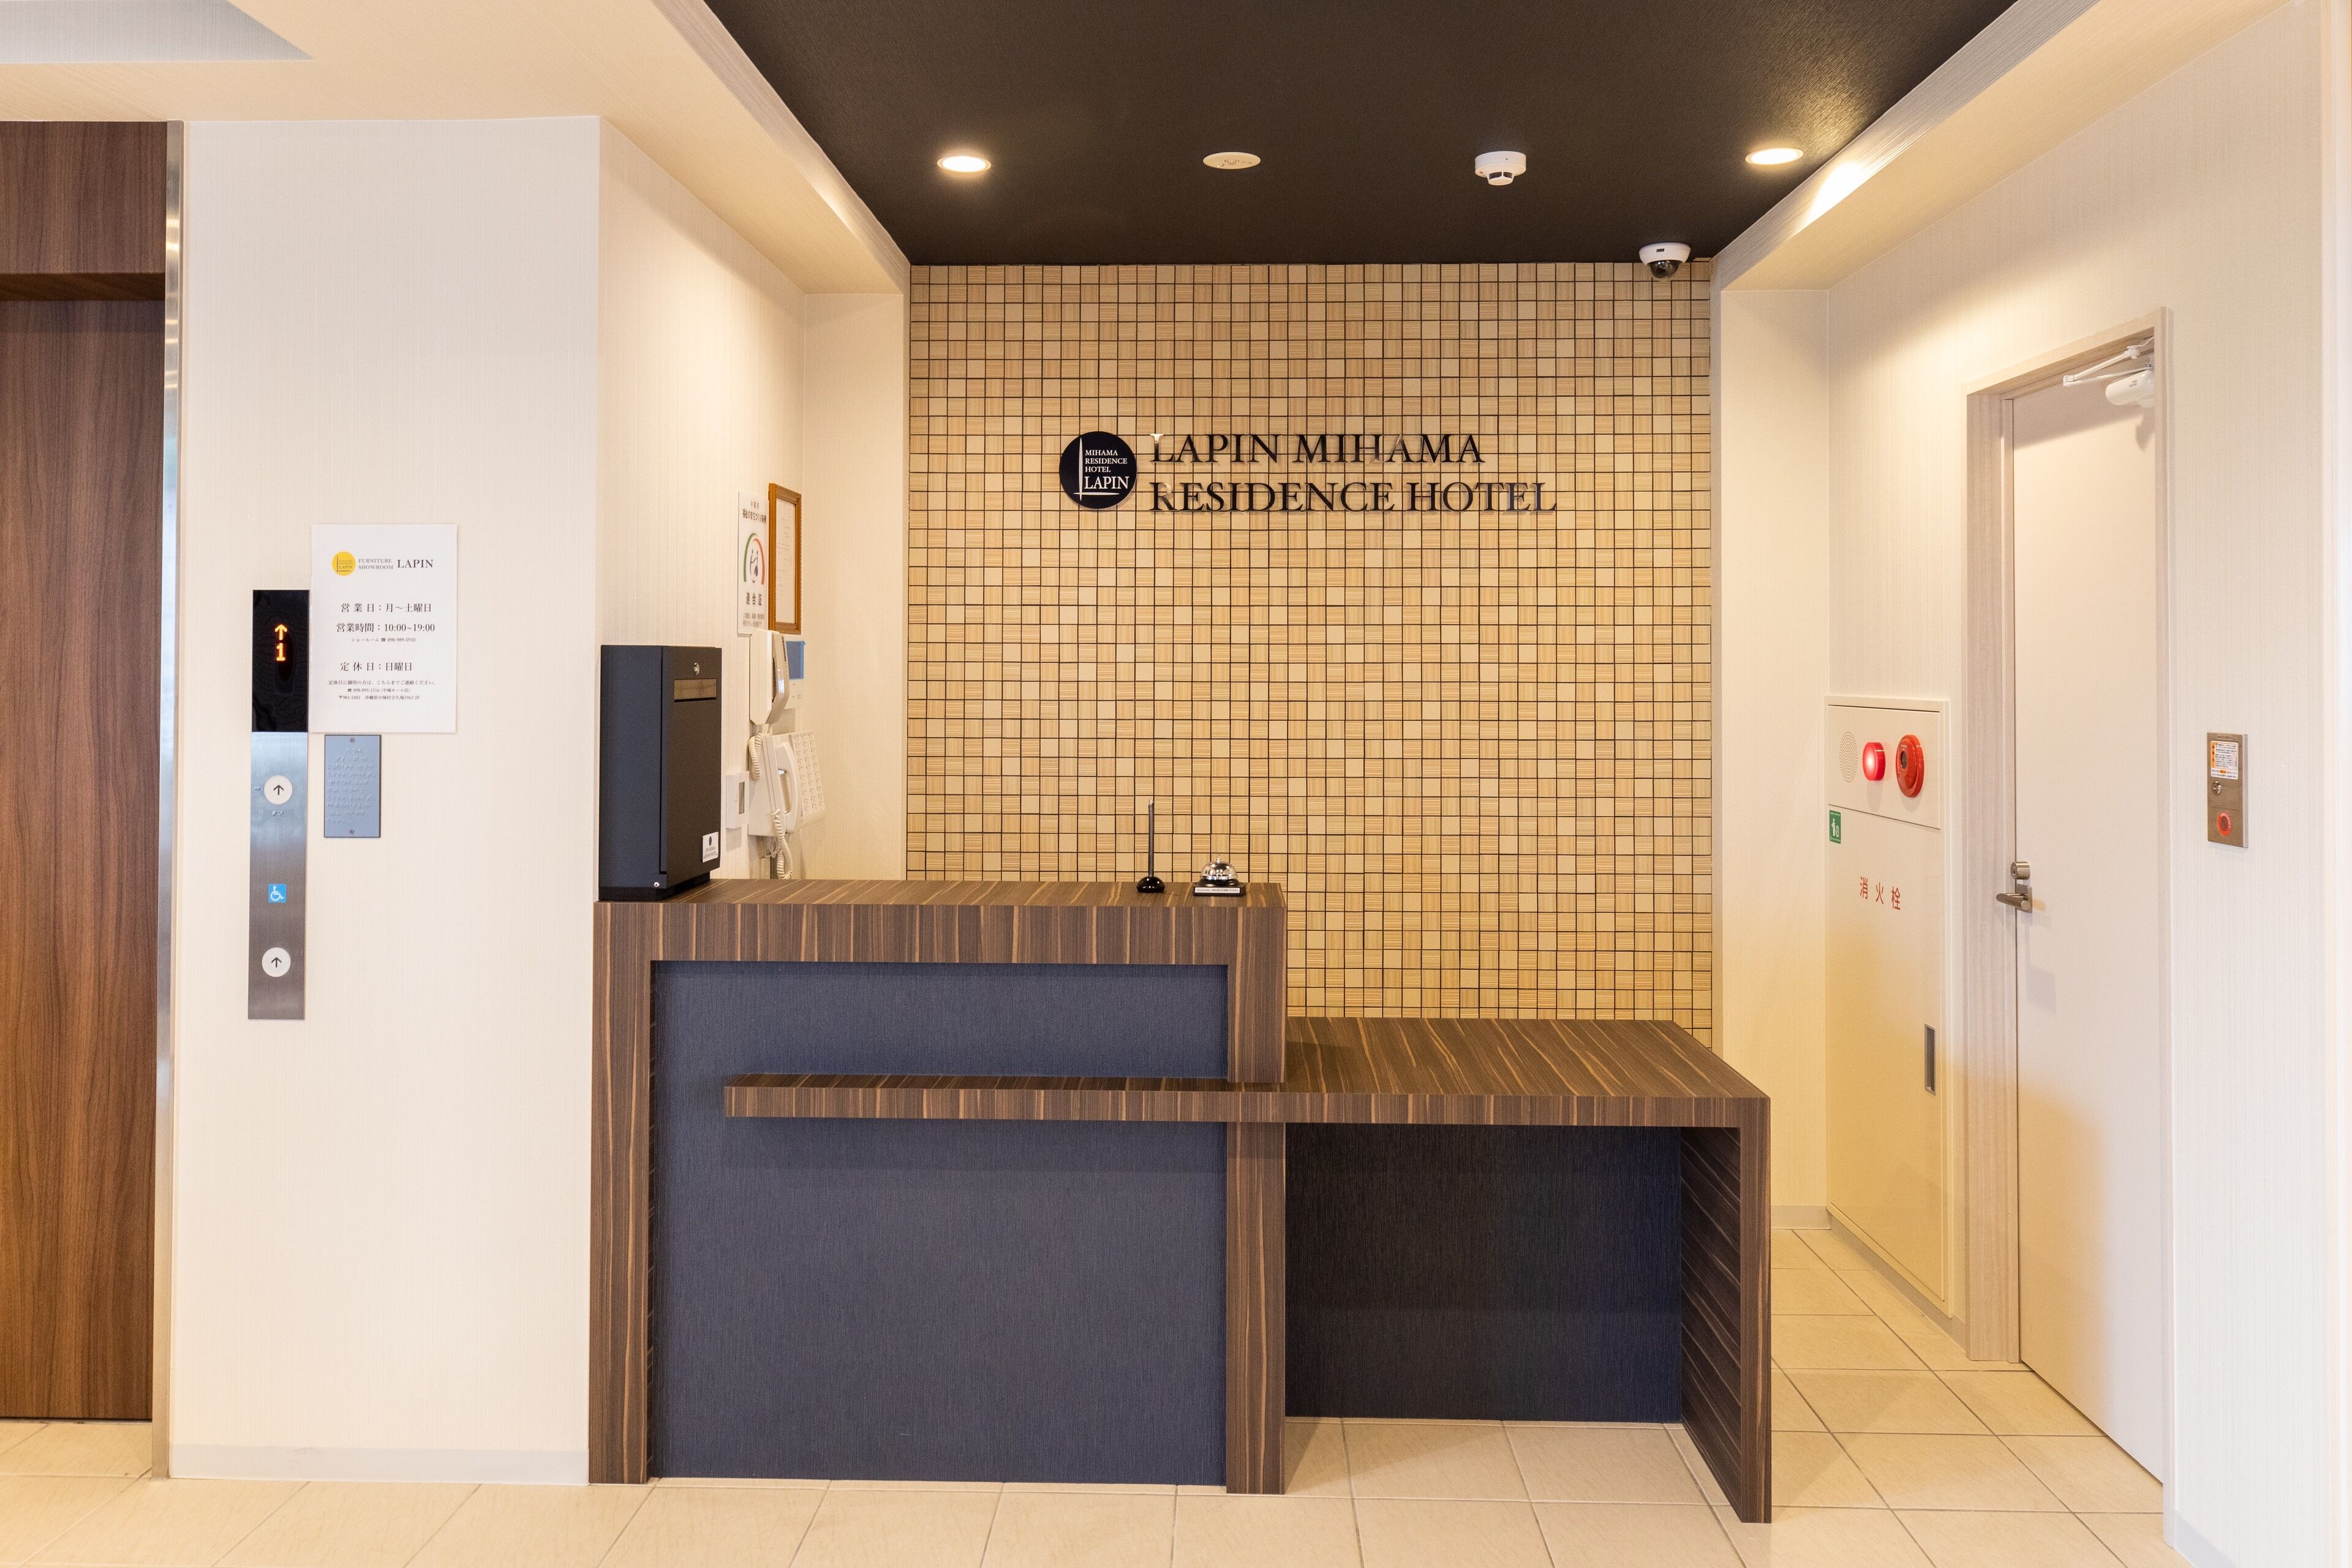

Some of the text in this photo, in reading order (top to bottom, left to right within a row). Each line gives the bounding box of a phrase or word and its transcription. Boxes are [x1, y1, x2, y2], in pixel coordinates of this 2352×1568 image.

[1150, 433, 1485, 464] LAPIN MIHAMA
[1084, 476, 1129, 489] LAPIN
[1150, 481, 1557, 512] RESIDENCE HOTEL
[397, 559, 434, 568] LAPIN
[276, 643, 285, 662] 1
[1860, 876, 1901, 910] 消火栓
